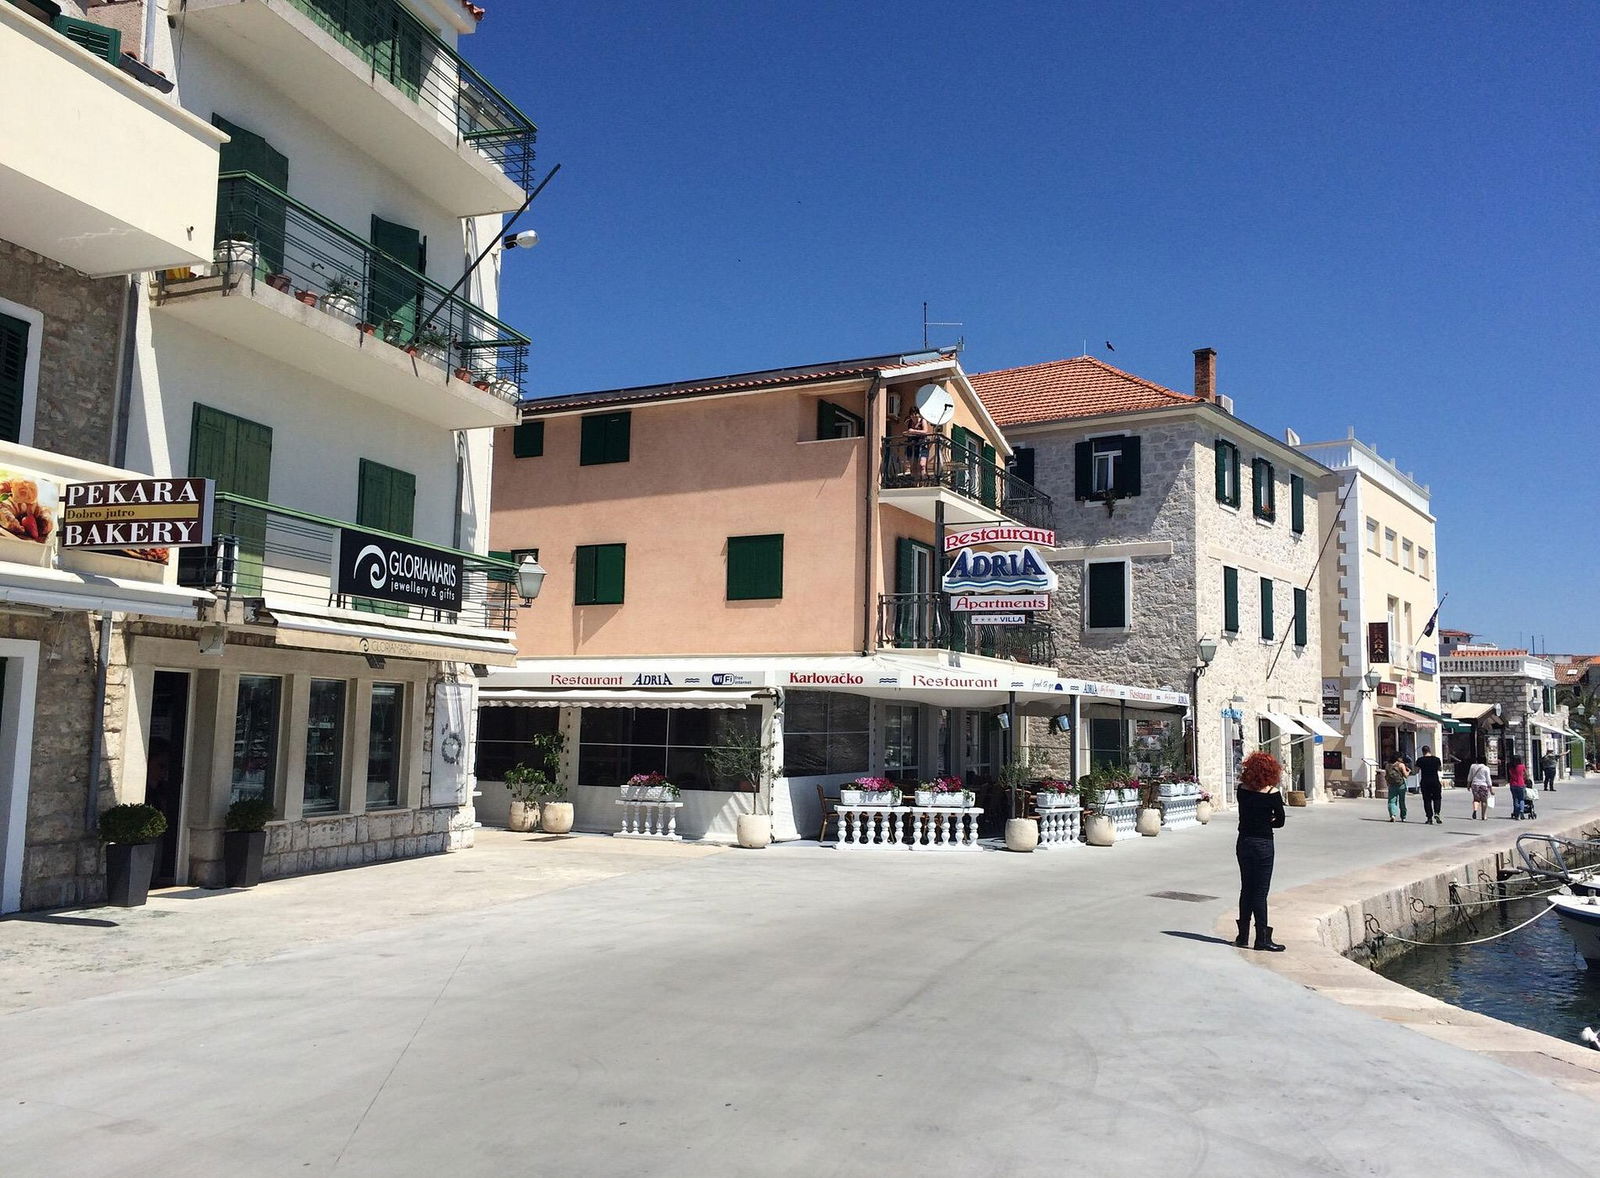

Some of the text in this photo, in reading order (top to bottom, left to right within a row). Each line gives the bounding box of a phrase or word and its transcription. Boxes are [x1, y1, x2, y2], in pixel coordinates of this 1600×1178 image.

[67, 481, 199, 507] PEKARA
[67, 507, 135, 520] Dobro jutro
[65, 521, 198, 546] BAKERY
[946, 528, 1054, 549] Restaurant
[389, 551, 457, 587] GLORIAMARIS
[947, 549, 1046, 578] ADRIA
[390, 578, 455, 601] jewellery & gifts
[955, 597, 1046, 610] Apartments
[550, 674, 623, 686] Restaurant
[632, 673, 674, 686] ADRIA
[789, 672, 998, 688] Karlovačko Restaurant
